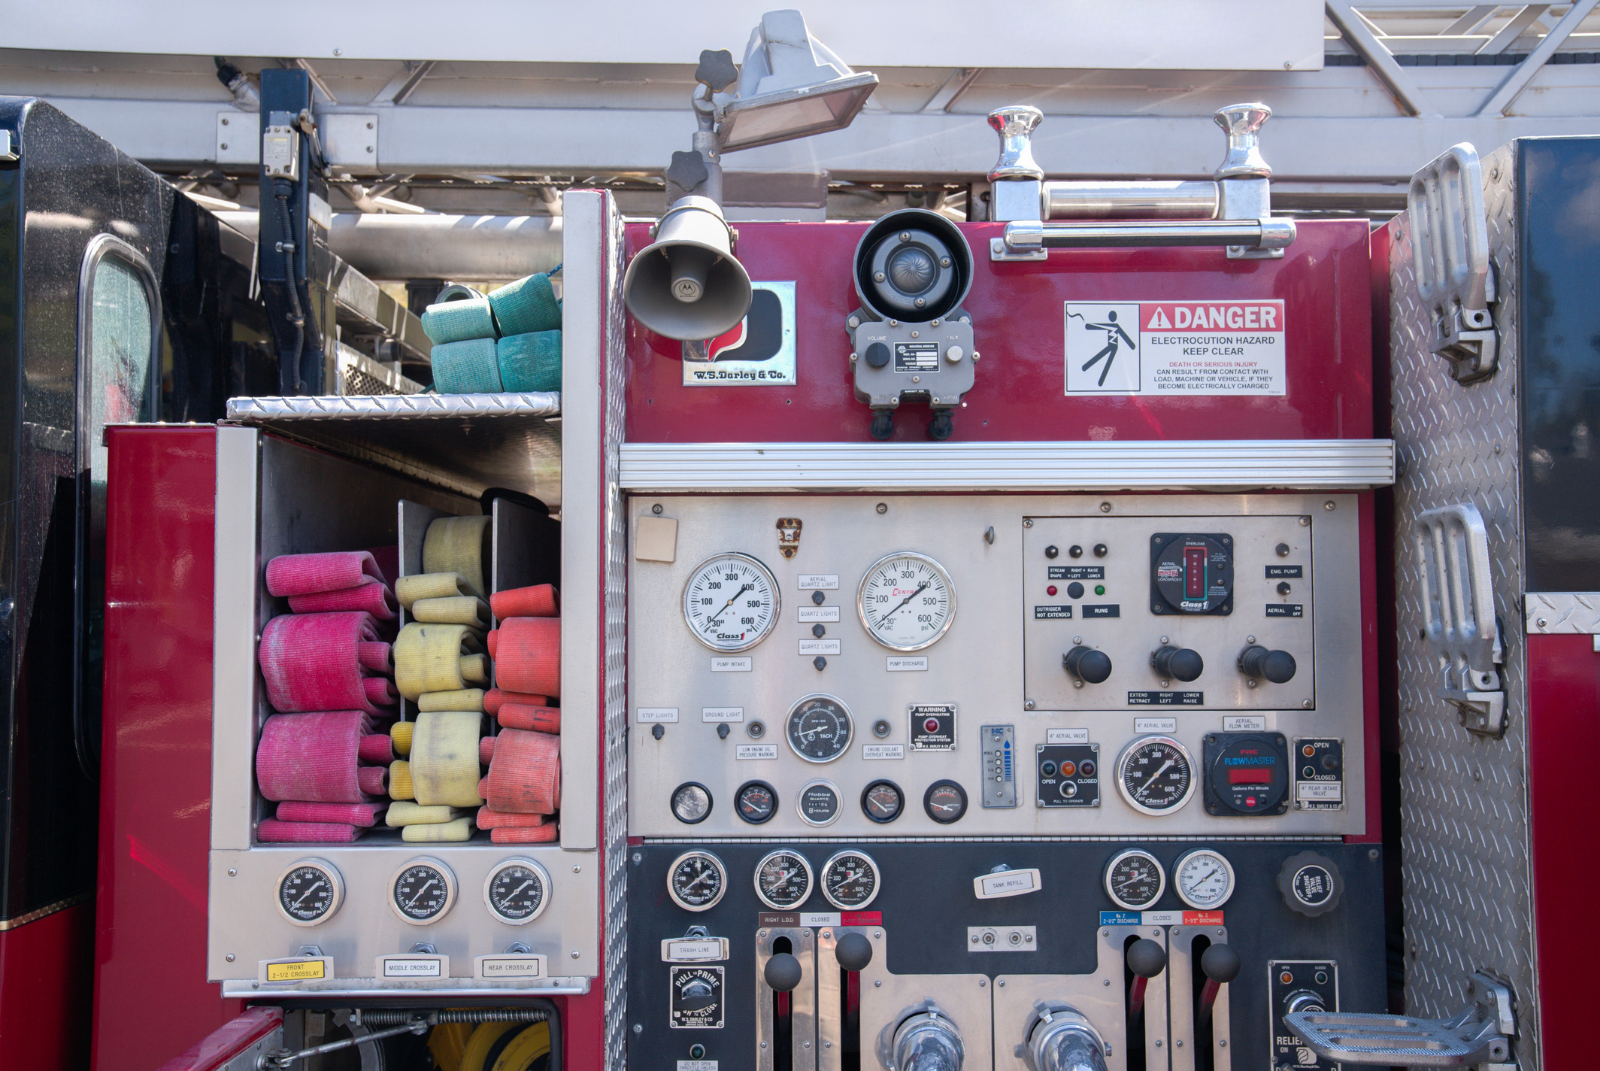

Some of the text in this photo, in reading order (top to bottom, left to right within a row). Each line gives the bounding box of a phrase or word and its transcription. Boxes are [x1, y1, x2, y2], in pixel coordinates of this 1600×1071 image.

[1174, 306, 1277, 329] DANGER
[1151, 336, 1275, 345] ELECTROCUTION HAZARD
[1183, 347, 1244, 356] KEEP CLEAR
[758, 370, 766, 379] &
[768, 370, 786, 379] Co.
[724, 573, 738, 581] 300
[901, 571, 915, 579] 300
[708, 582, 722, 590] 200
[883, 578, 897, 587] 200
[701, 598, 713, 606] 100
[876, 595, 888, 603] 100
[923, 597, 937, 606] 500
[747, 600, 760, 608] 500
[741, 617, 754, 625] 600
[917, 614, 932, 623] 600
[1224, 756, 1275, 766] FLOWMASTER
[1303, 875, 1313, 898] SHUTOFF
[1310, 877, 1318, 894] VALVE
[1315, 875, 1323, 894] RELIEF
[290, 970, 320, 978] CROSSLAY
[675, 969, 720, 989] PULL PRIME
[700, 1002, 718, 1018] CLOSE
[1276, 1036, 1303, 1045] RELIE
